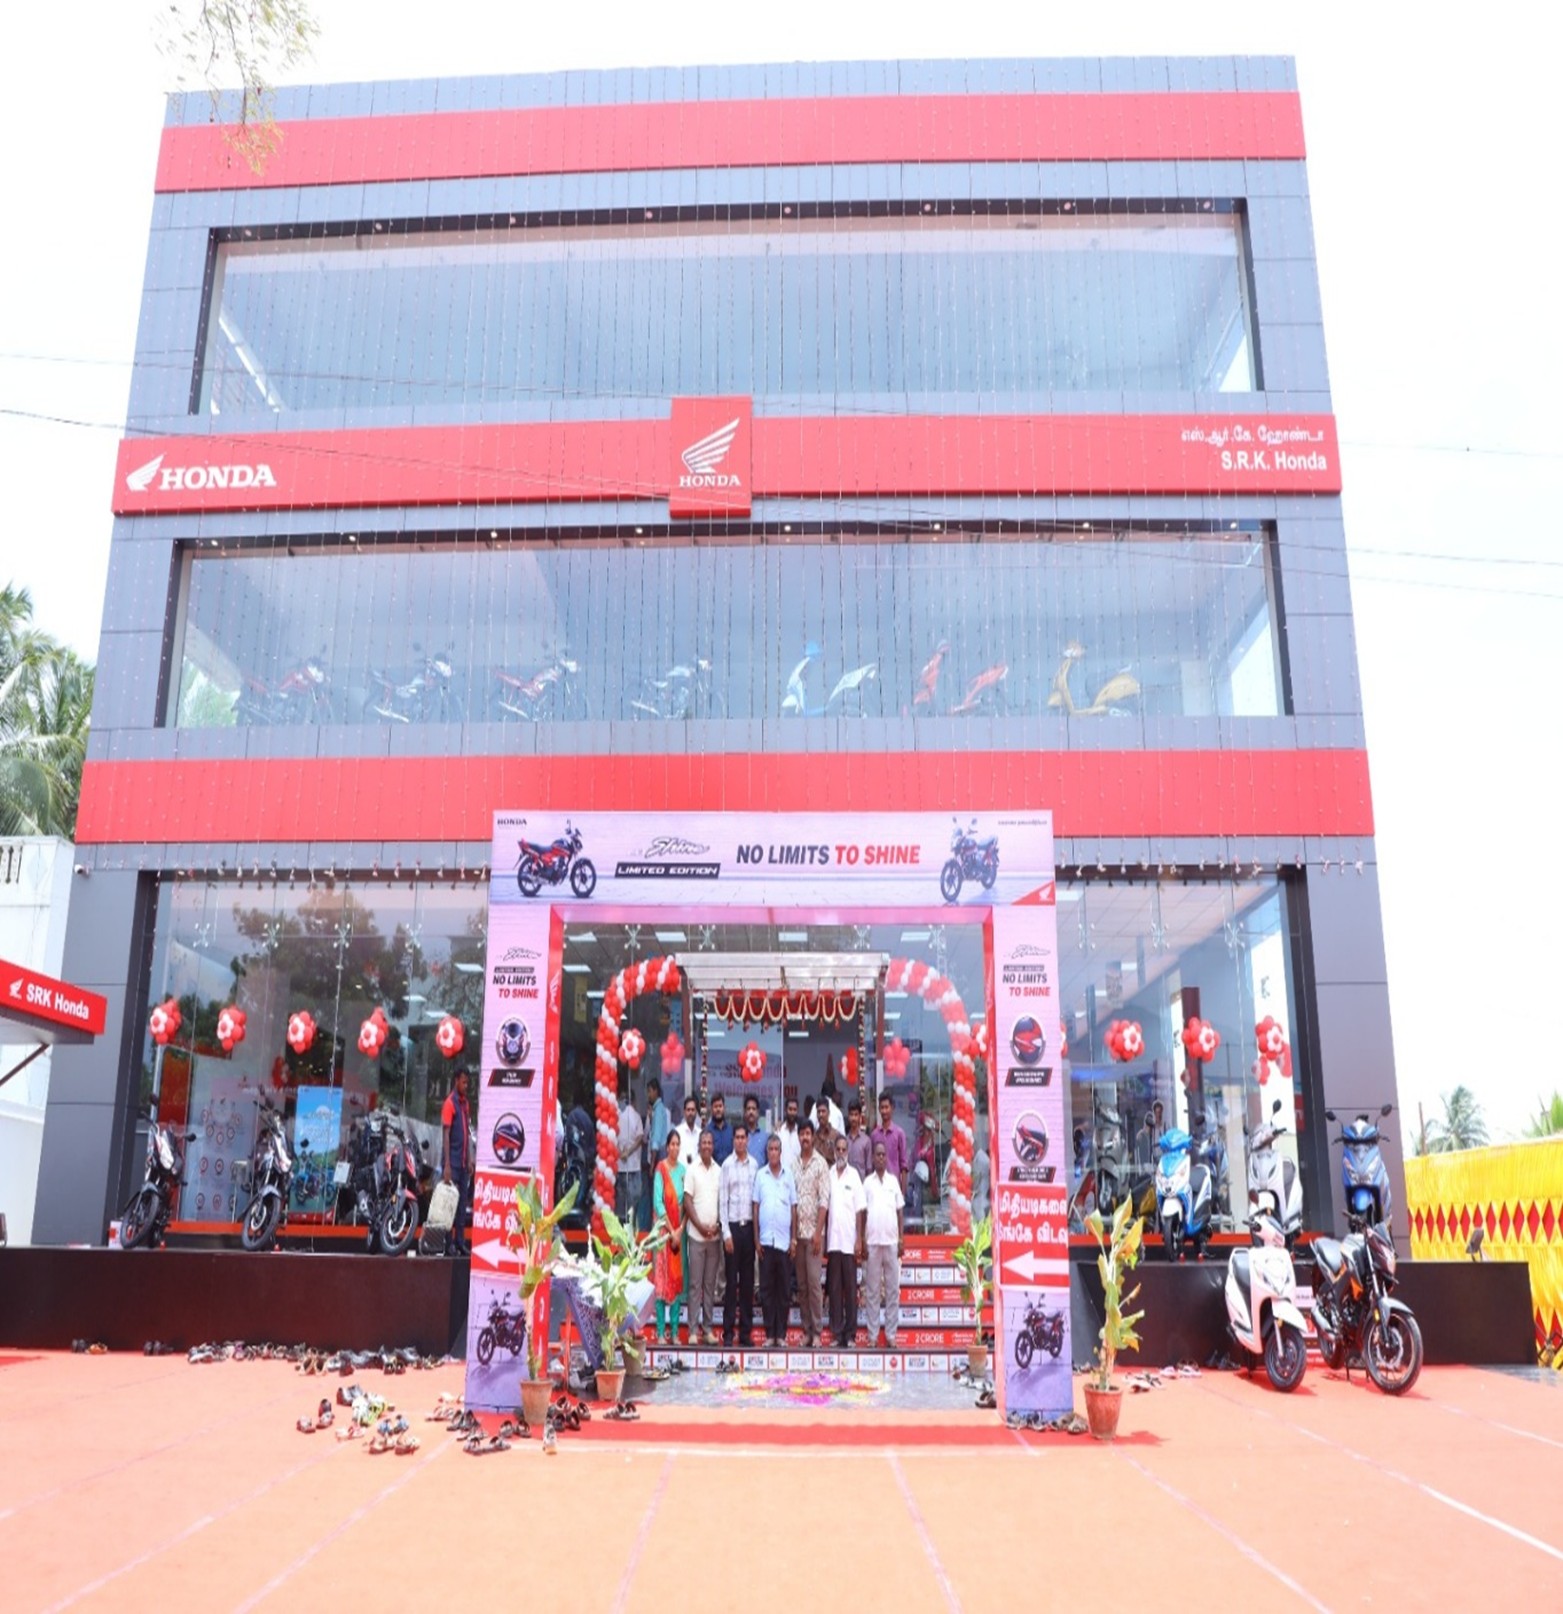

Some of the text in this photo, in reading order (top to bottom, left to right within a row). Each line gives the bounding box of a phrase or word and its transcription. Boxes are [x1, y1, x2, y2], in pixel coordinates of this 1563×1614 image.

[1221, 450, 1327, 470] S.R.K. Honda
[159, 464, 277, 491] HONDA
[679, 474, 742, 488] HONDA
[496, 818, 528, 826] HONDA
[736, 845, 921, 866] NO LIMITS TO SHINE
[617, 865, 718, 876] LIMITED EDITION
[492, 974, 537, 987] NO LIMITS
[1002, 973, 1048, 985] NO LIMITS
[498, 988, 539, 999] TO SHINE
[1009, 986, 1051, 997] TO SHINE
[26, 983, 90, 1020] SRK Honda
